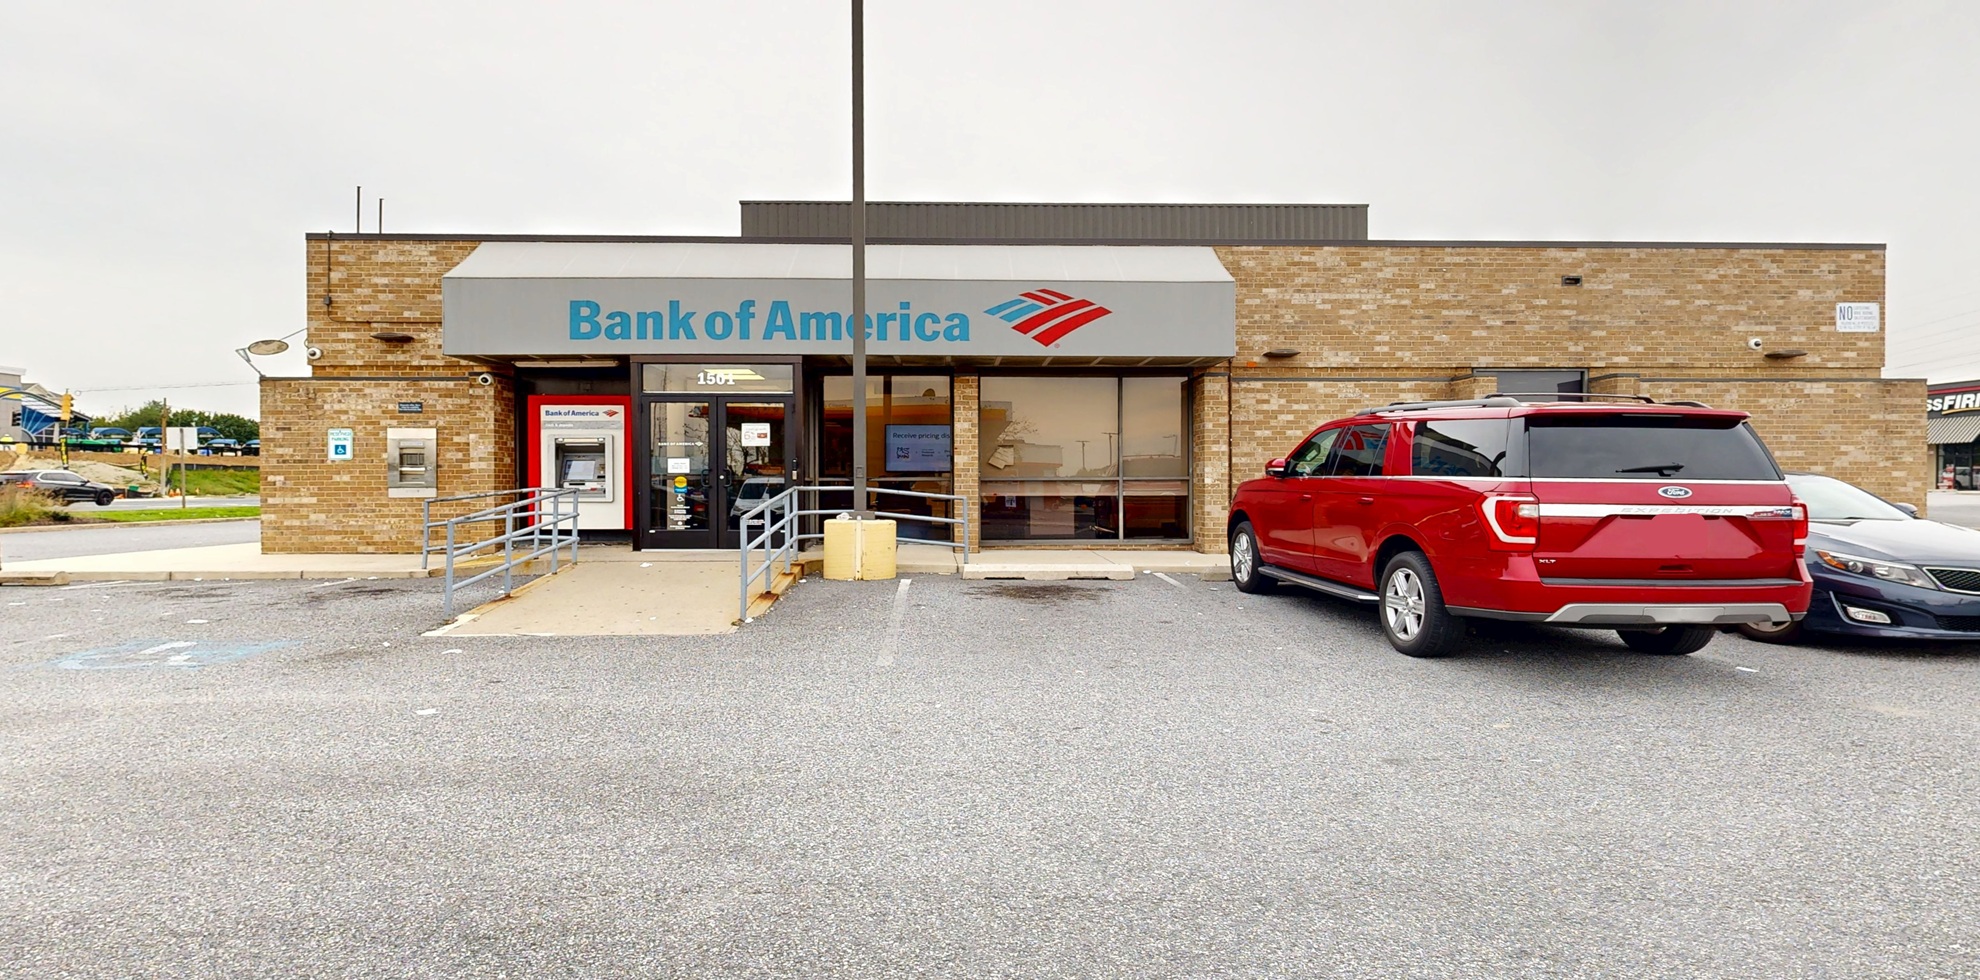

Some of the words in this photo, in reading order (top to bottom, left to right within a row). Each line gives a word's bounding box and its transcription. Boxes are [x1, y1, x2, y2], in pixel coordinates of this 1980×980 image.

[1839, 306, 1853, 321] NO
[569, 300, 698, 341] Bank
[704, 300, 756, 341] of
[762, 300, 970, 342] America
[697, 372, 736, 385] 1501
[918, 432, 940, 440] pricing
[1666, 488, 1686, 497] Ford
[1621, 506, 1734, 515] EXPEDITION
